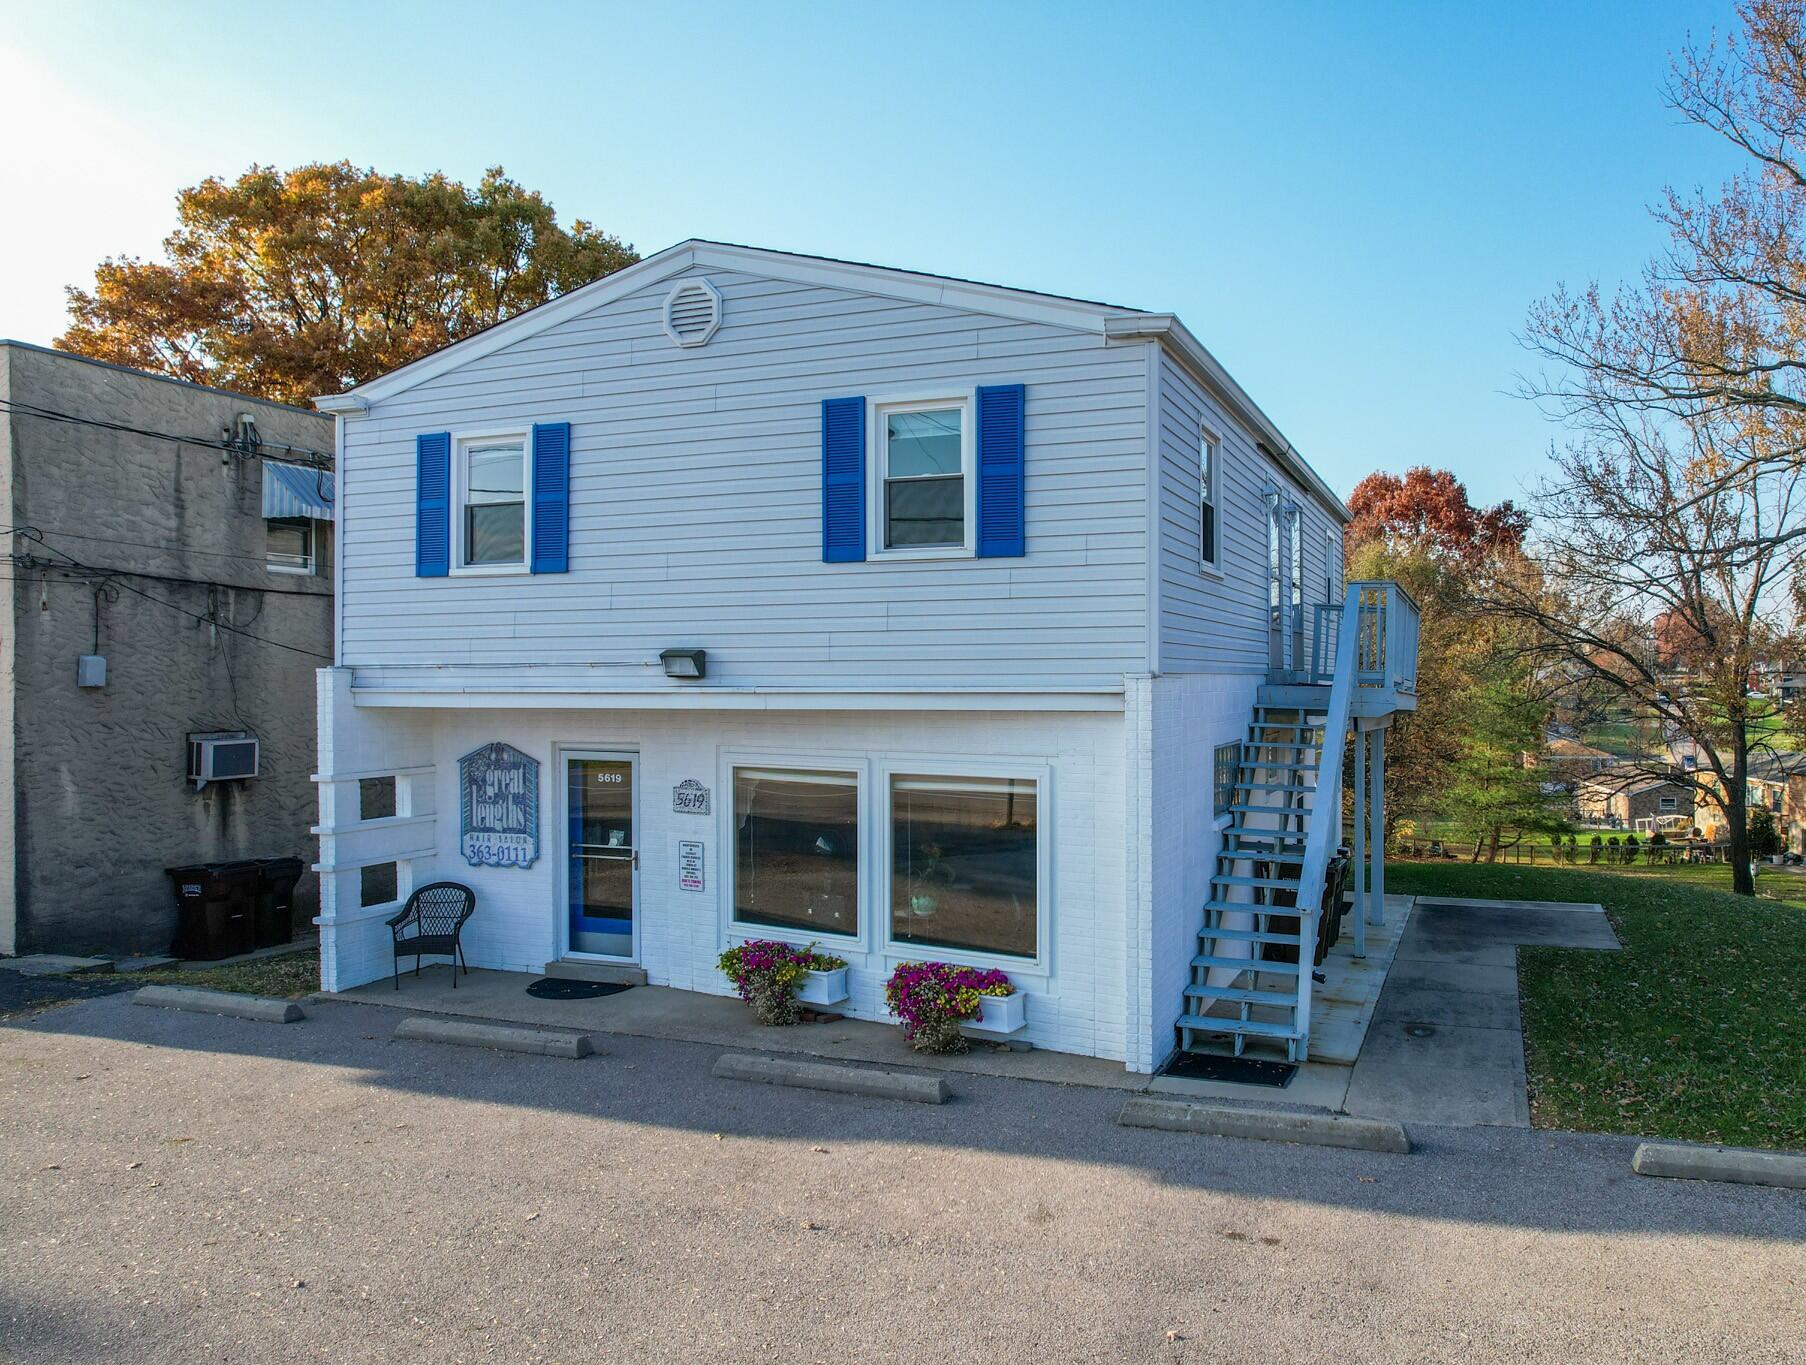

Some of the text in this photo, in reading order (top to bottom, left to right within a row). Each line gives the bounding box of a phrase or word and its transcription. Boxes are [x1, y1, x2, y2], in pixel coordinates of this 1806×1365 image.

[485, 764, 525, 801] great
[597, 773, 622, 783] 5619
[472, 785, 525, 832] lengths
[676, 792, 705, 809] 5619
[469, 833, 527, 844] HAIR SALON
[469, 844, 528, 862] 363-0111
